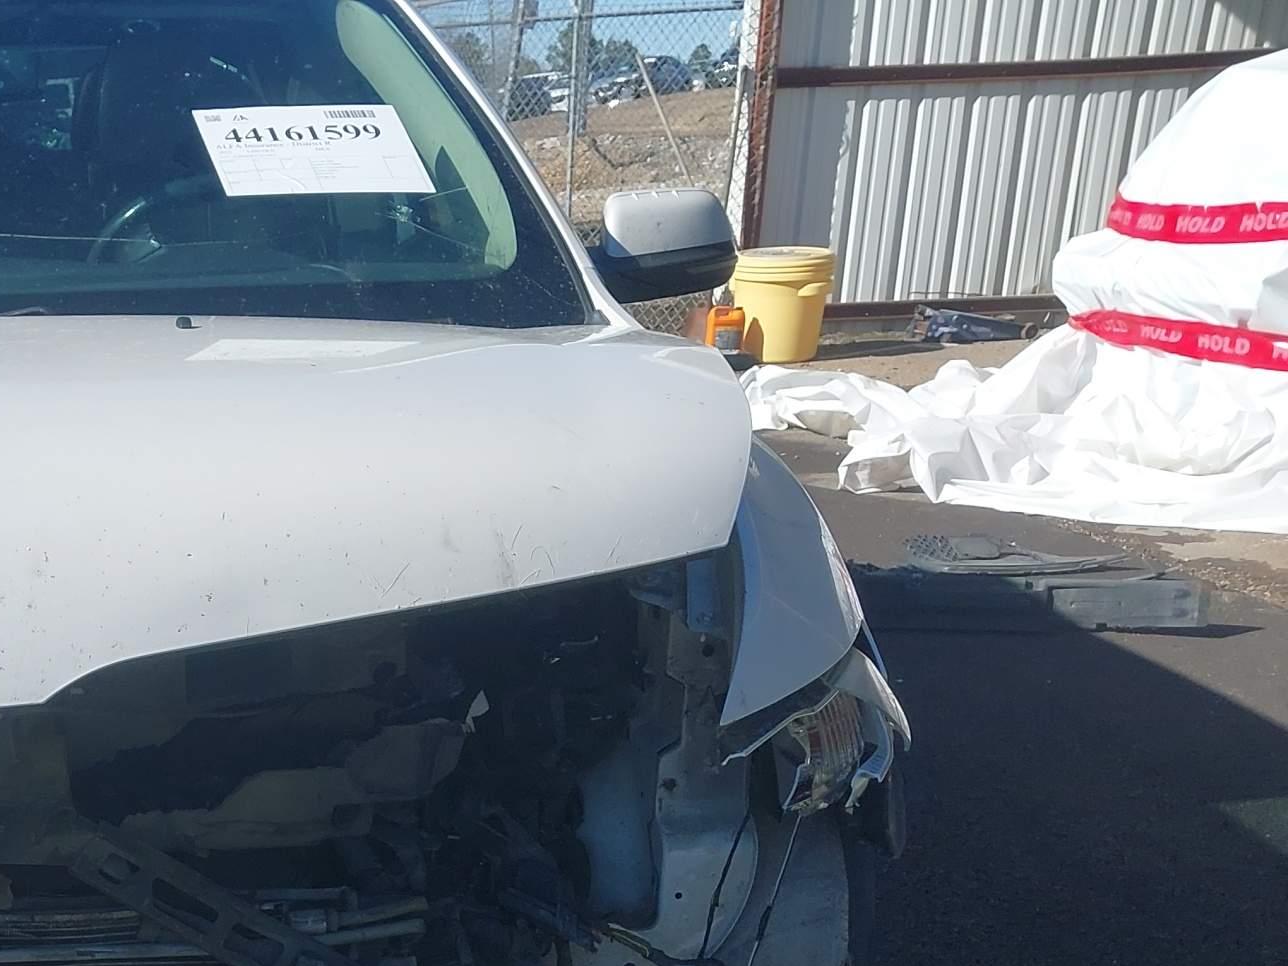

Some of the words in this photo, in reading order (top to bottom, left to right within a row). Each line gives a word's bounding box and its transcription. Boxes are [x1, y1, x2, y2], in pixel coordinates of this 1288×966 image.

[225, 123, 381, 143] 44161599
[1136, 214, 1165, 231] HOLD
[1175, 216, 1226, 233] HOLD
[1239, 212, 1288, 233] HOLD
[1198, 334, 1251, 355] HOLD
